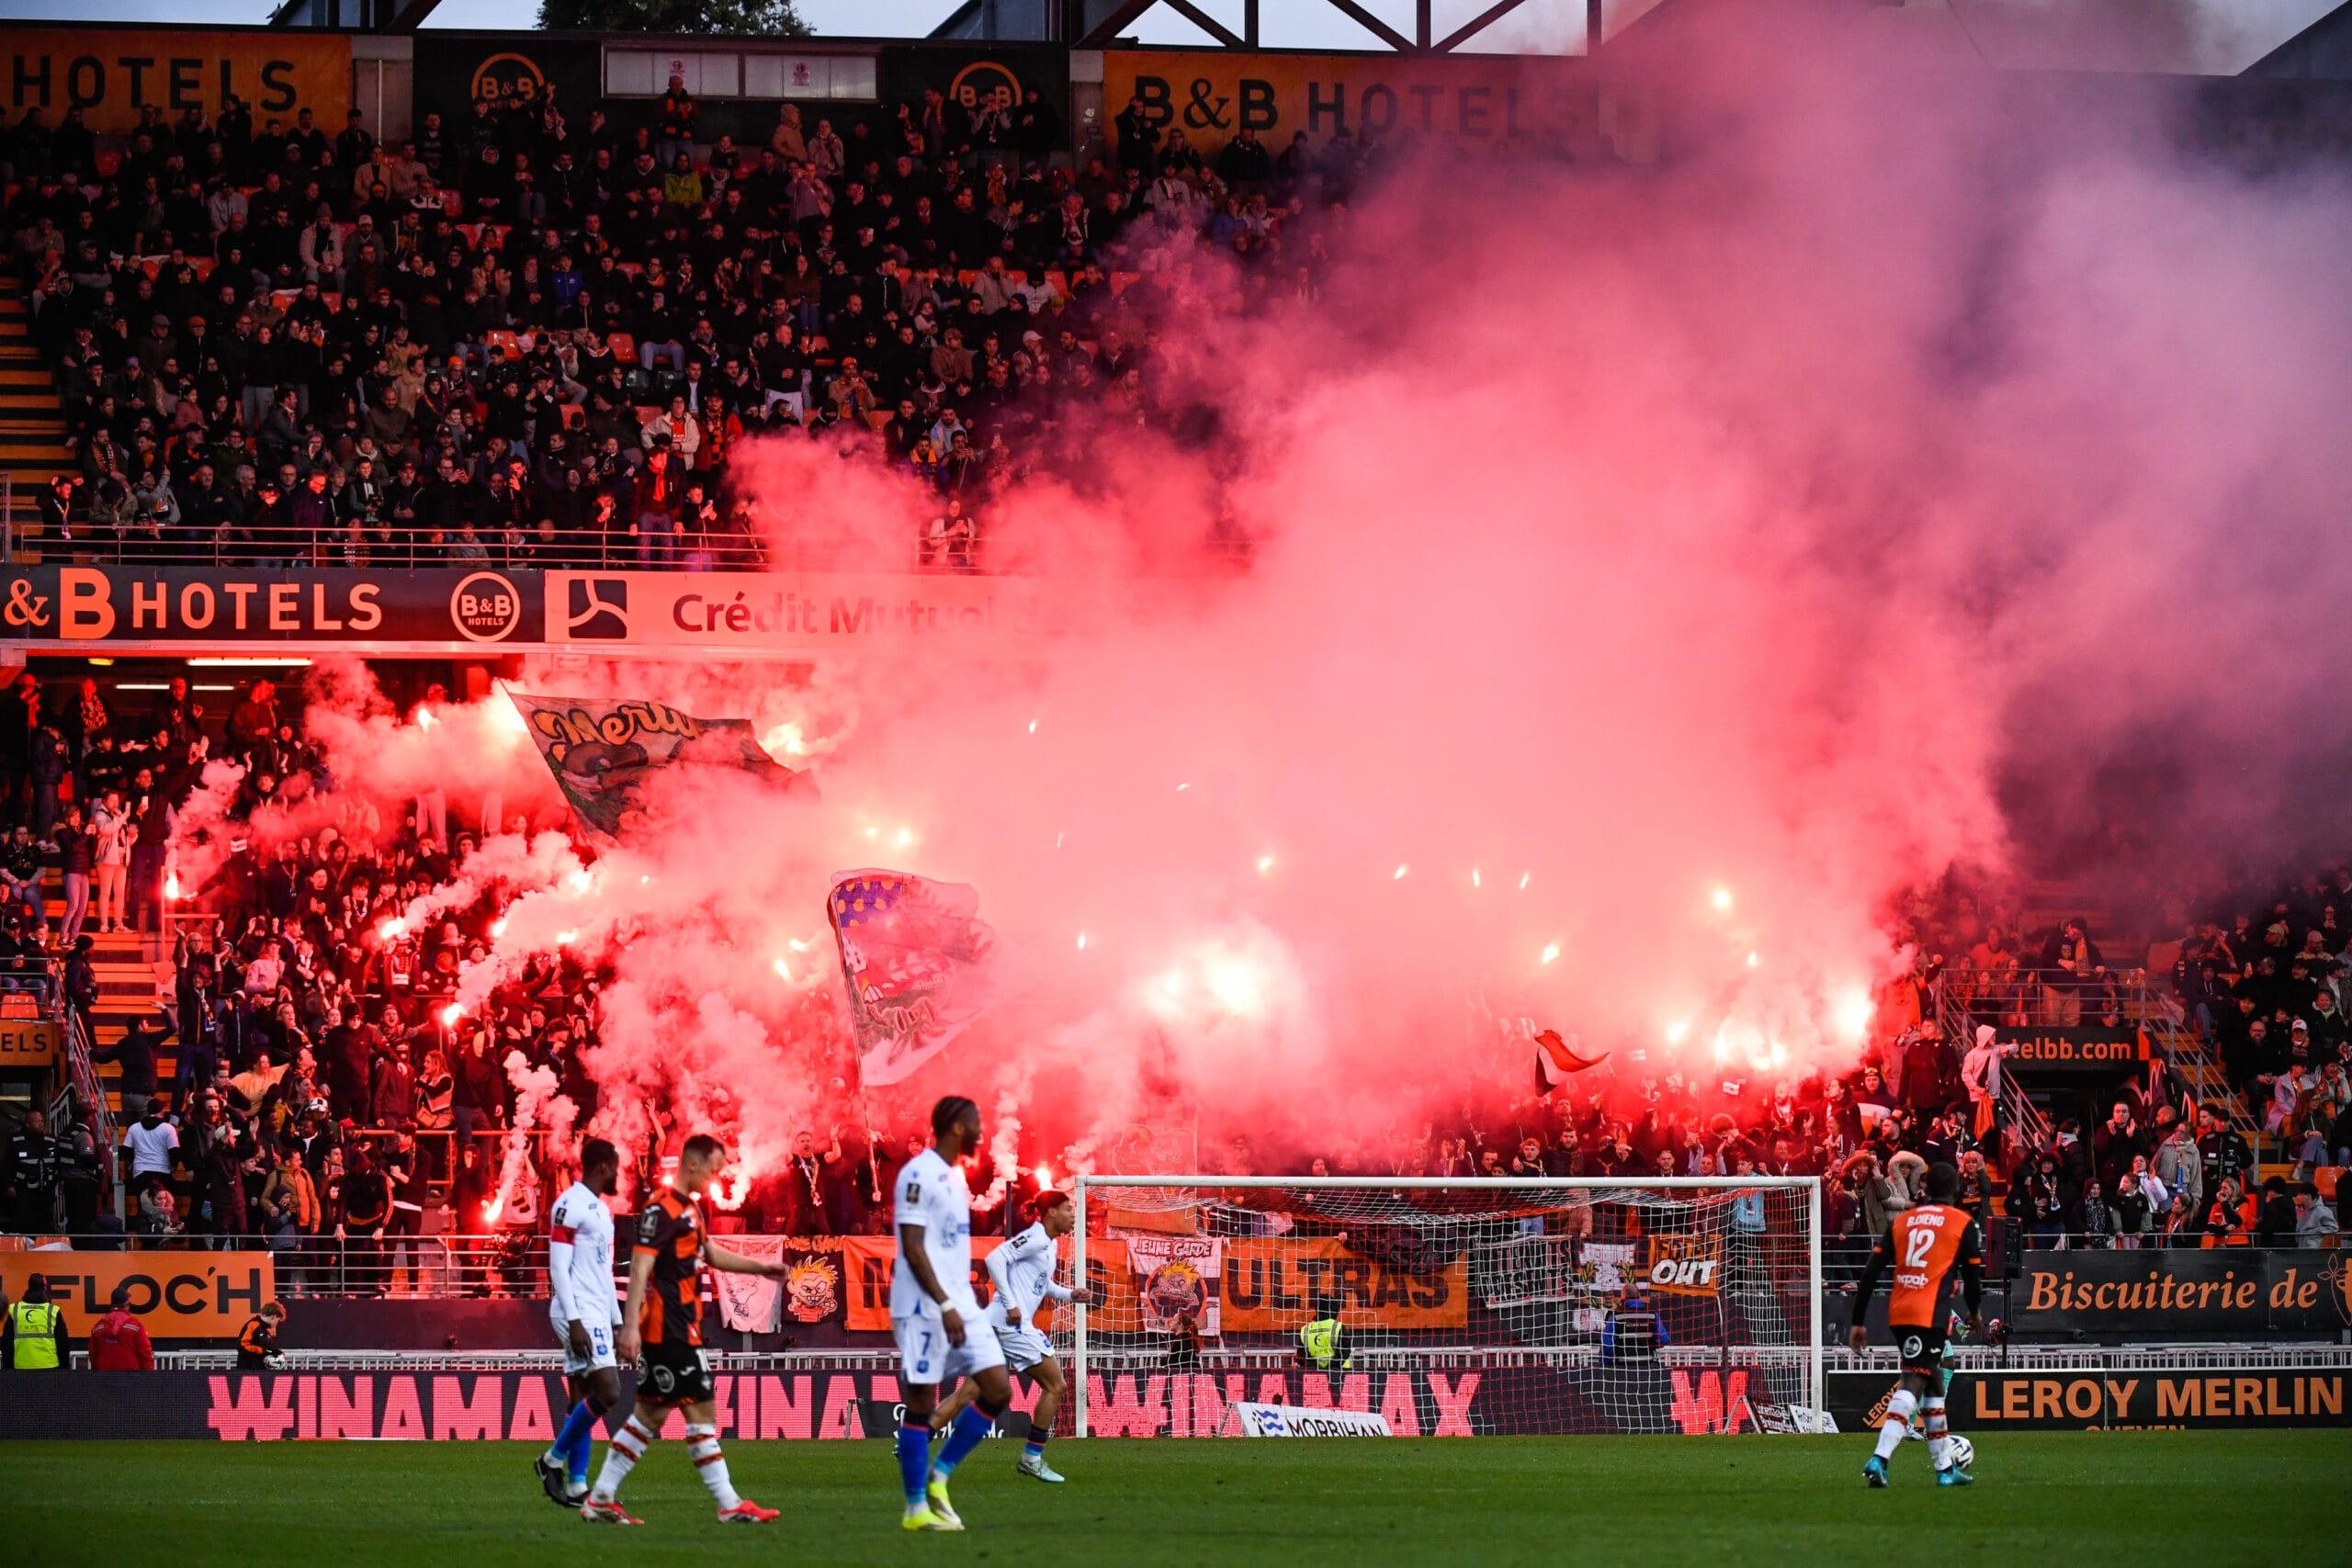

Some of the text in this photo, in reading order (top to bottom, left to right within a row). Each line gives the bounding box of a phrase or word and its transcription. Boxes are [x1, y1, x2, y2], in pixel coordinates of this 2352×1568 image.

[13, 54, 298, 112] HOTELS
[960, 85, 1012, 107] BB
[1135, 75, 1279, 131] B&B
[132, 582, 382, 631] HOTELS
[460, 595, 511, 615] B&B
[468, 617, 504, 626] HOTELS
[673, 592, 819, 634] Crédit
[1136, 1239, 1212, 1258] JEUNE GARDE
[1905, 1228, 1935, 1268] 12
[1227, 1258, 1450, 1311] ULTRAS
[1651, 1258, 1717, 1285] OUT
[2026, 1268, 2318, 1311] Biscuiterie de
[921, 1331, 932, 1356] 7
[1975, 1376, 2343, 1419] LEROY MERLIN
